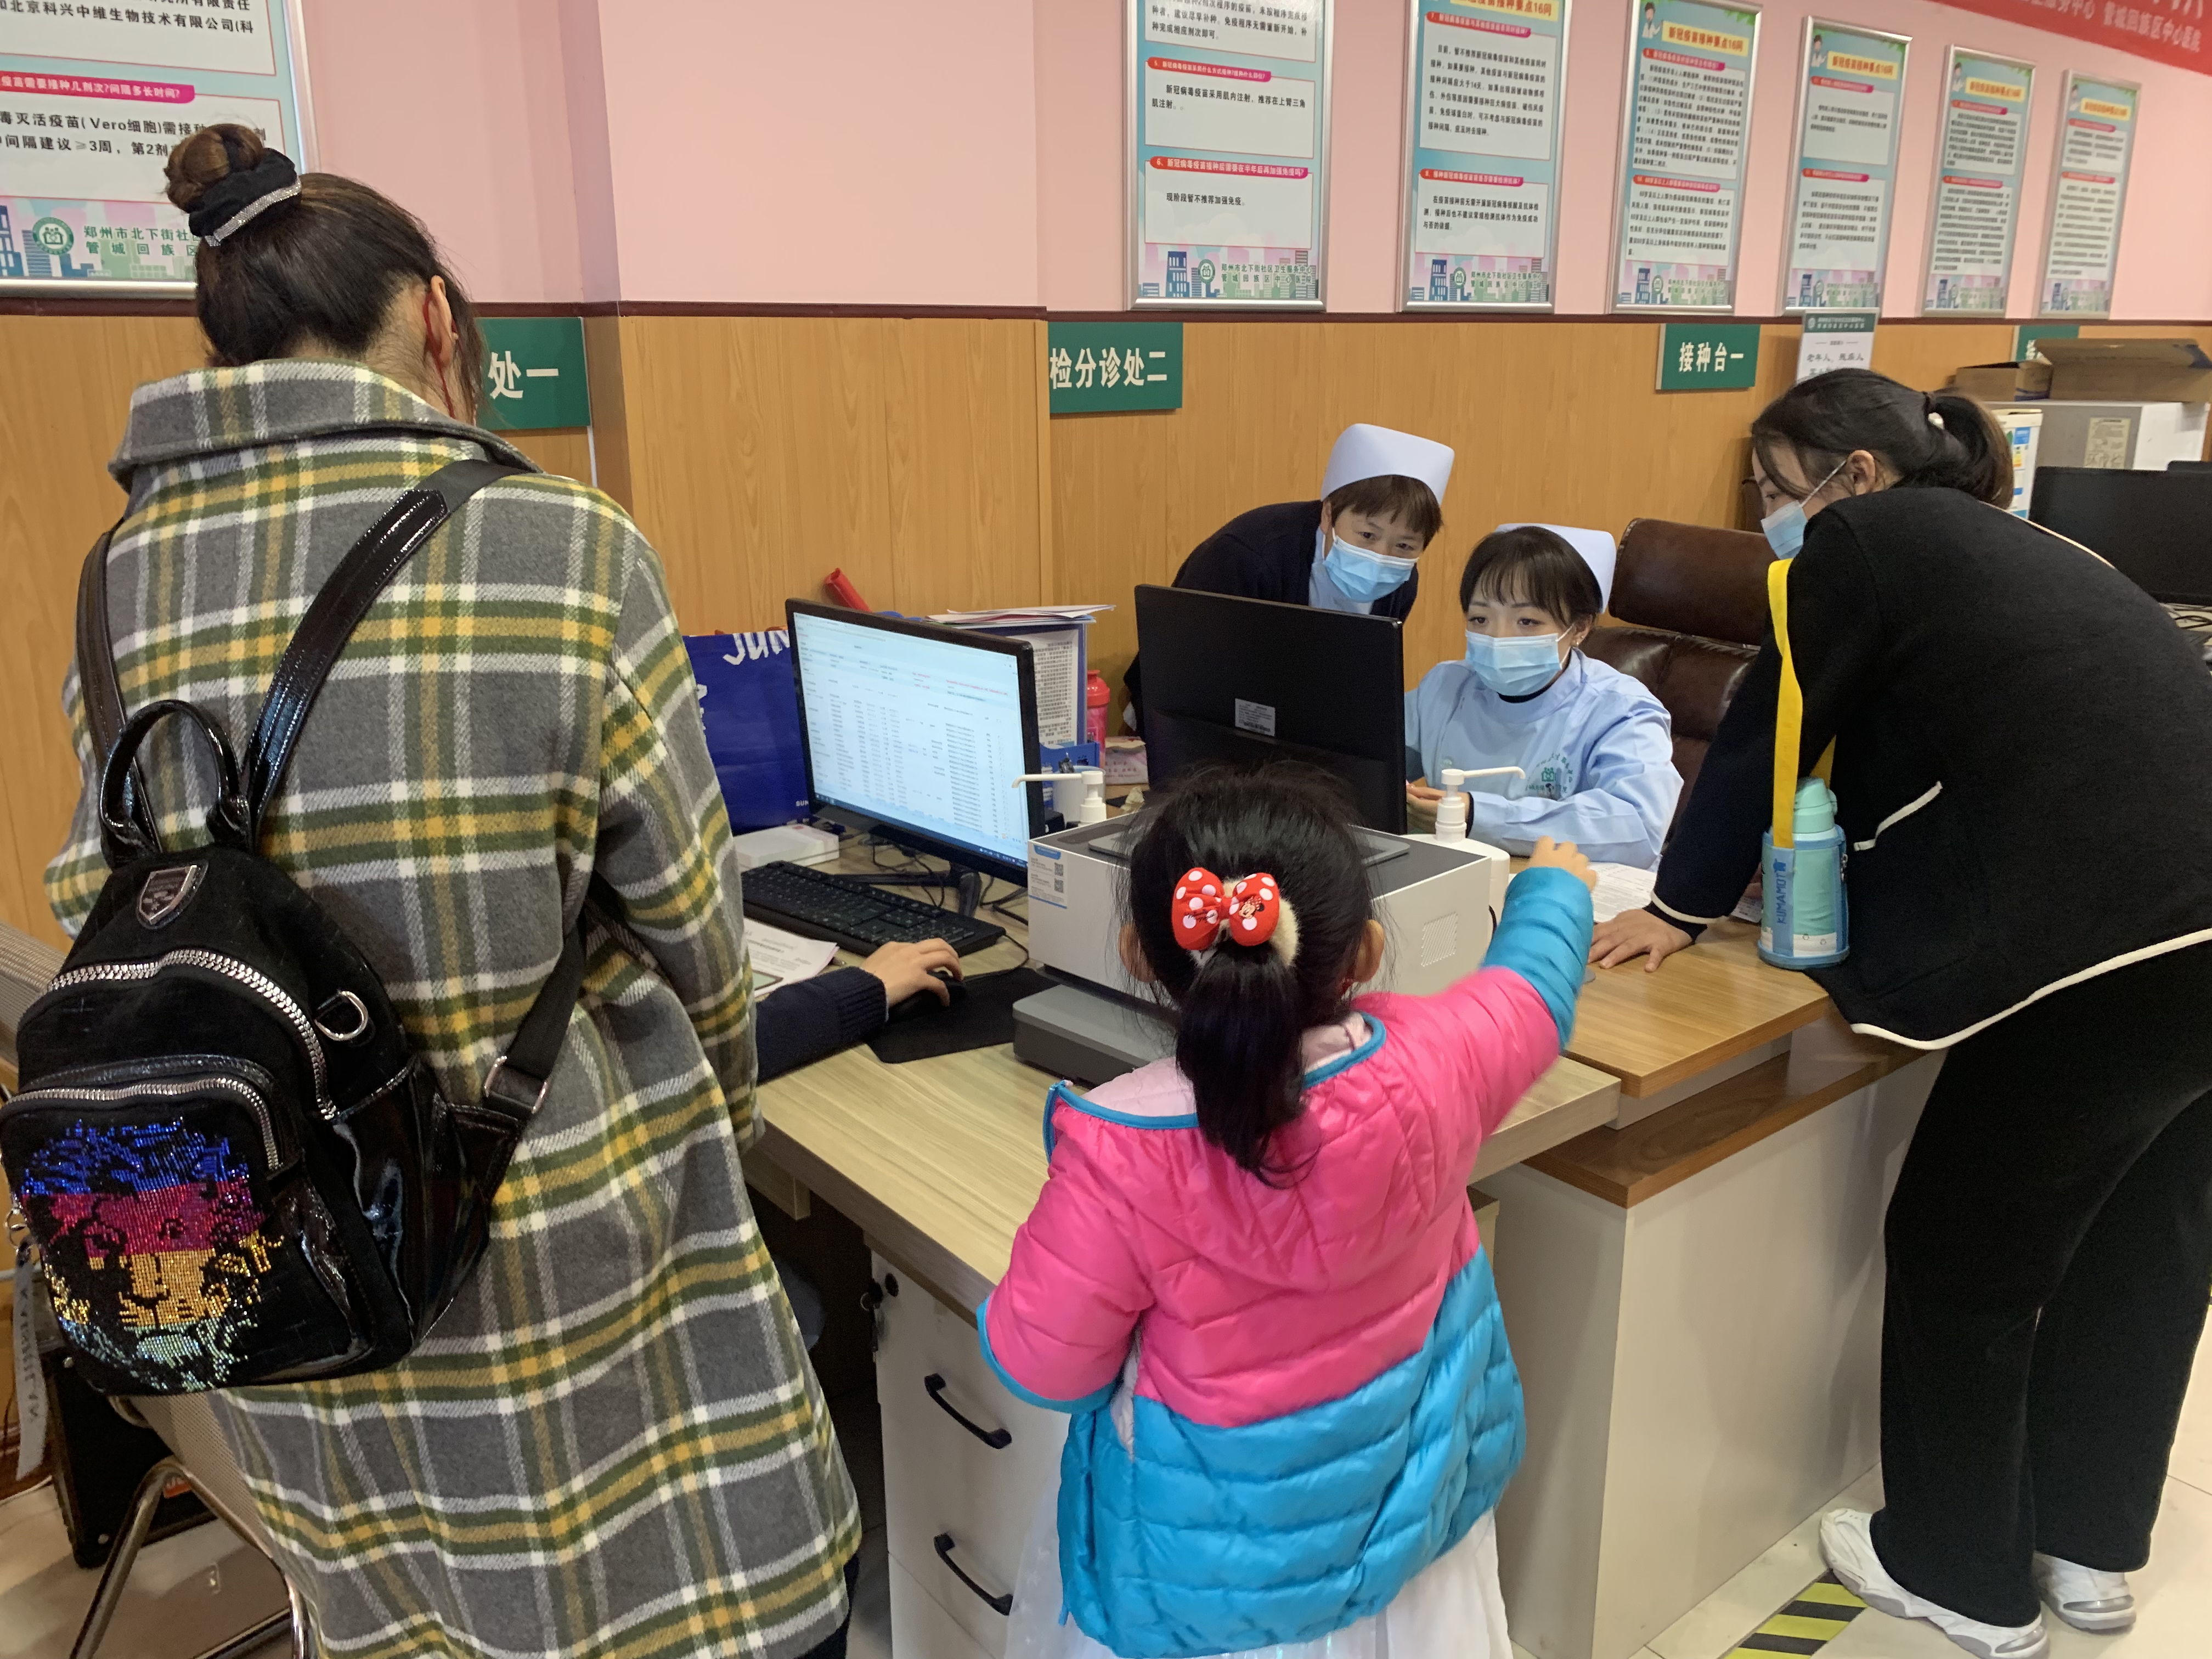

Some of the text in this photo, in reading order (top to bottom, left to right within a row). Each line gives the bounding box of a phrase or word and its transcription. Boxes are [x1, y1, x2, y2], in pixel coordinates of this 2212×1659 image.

[488, 351, 558, 399] 处一
[1049, 347, 1167, 389] 检分诊处二
[1679, 341, 1744, 373] 接种台一
